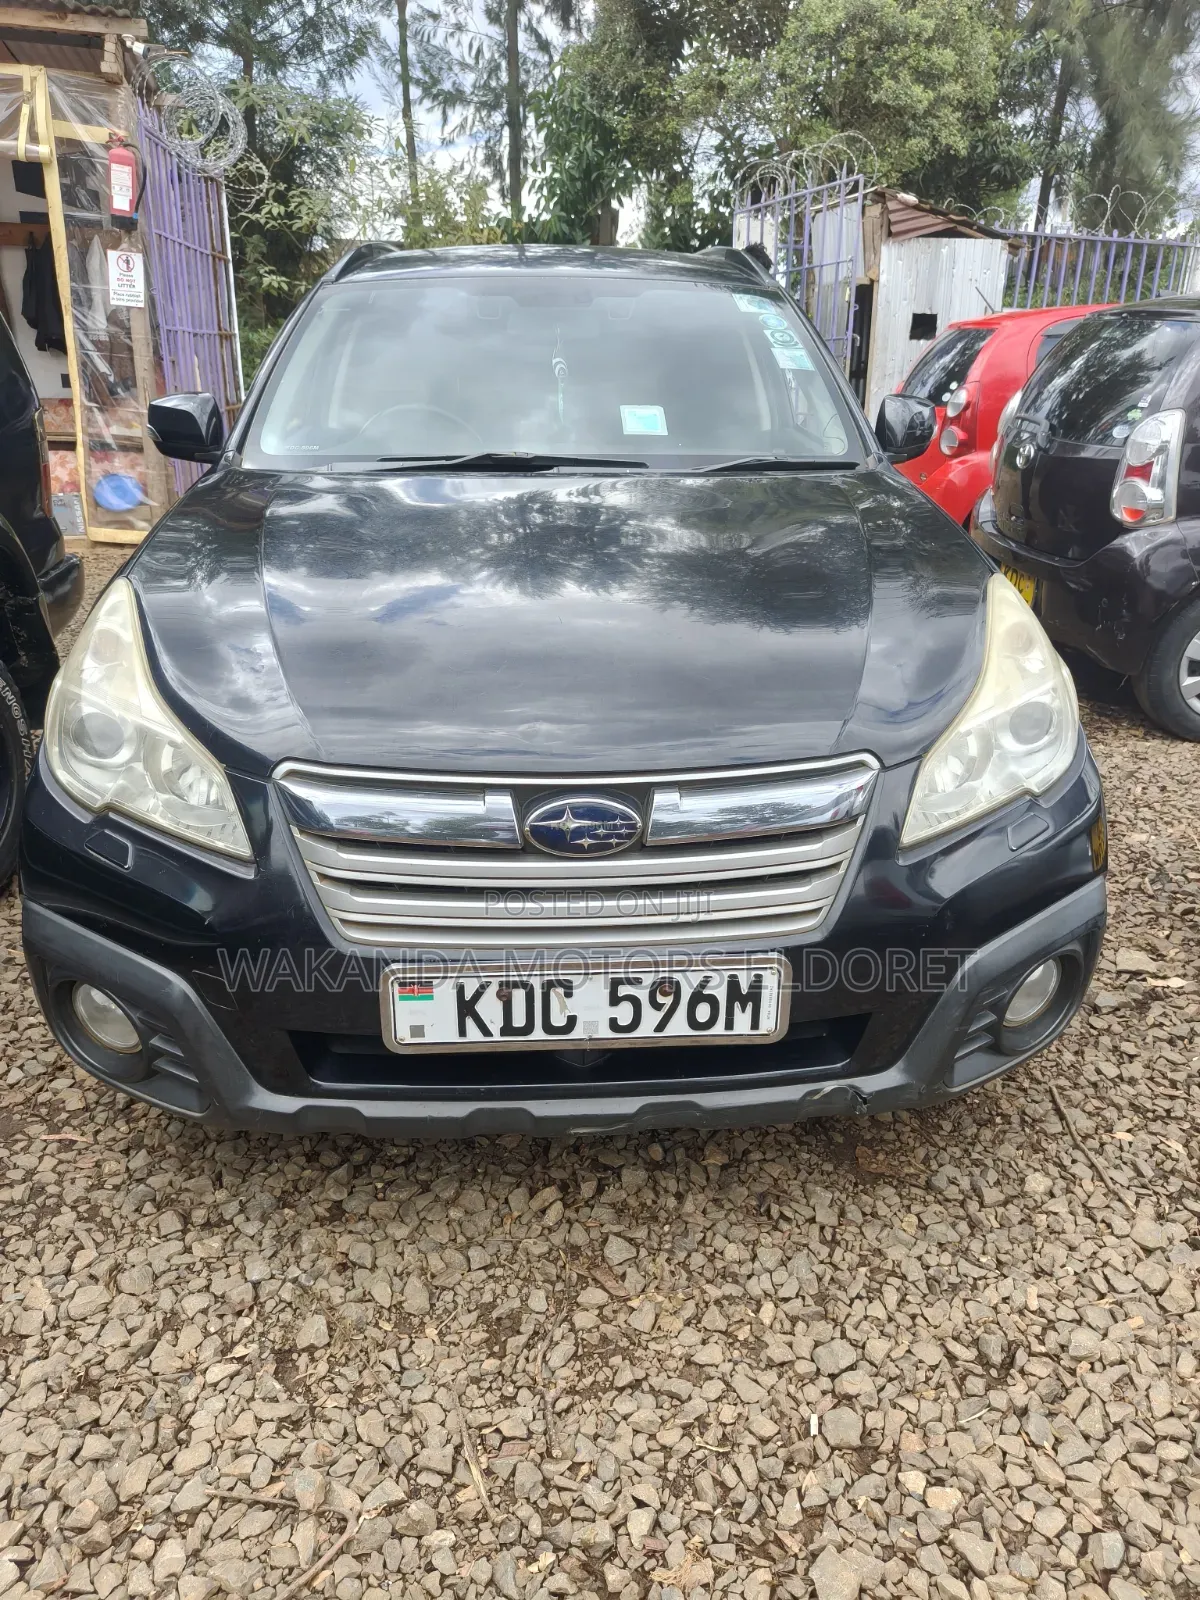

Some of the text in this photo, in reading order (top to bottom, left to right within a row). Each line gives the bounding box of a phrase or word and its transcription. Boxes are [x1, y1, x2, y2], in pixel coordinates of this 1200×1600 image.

[73, 496, 85, 532] NISSAN
[456, 973, 764, 1038] KDC 596M
